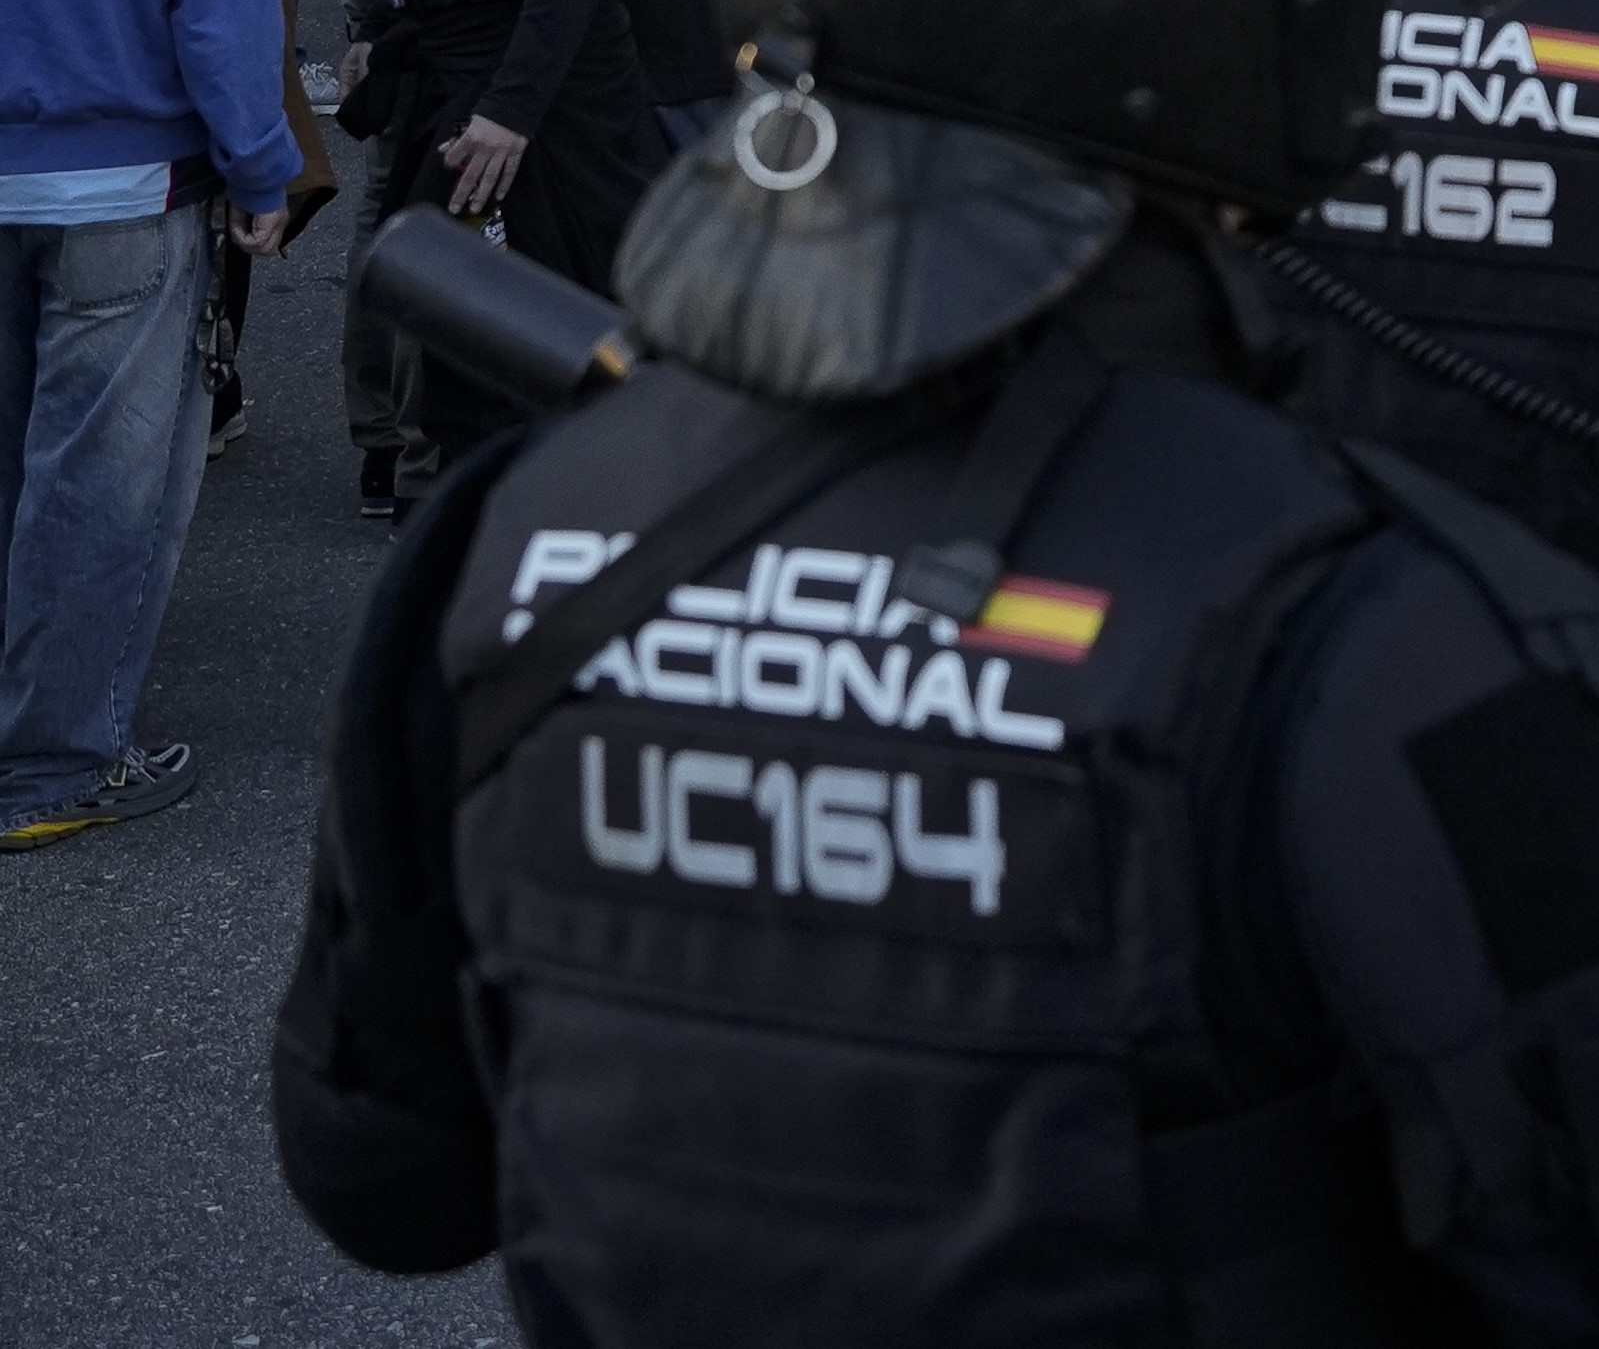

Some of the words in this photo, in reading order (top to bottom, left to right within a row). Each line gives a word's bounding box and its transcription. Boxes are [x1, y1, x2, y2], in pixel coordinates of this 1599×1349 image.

[1380, 9, 1540, 76] ICIA
[510, 527, 961, 645] PLICI
[503, 610, 1067, 751] ACIONAL
[579, 733, 1006, 919] UC164
